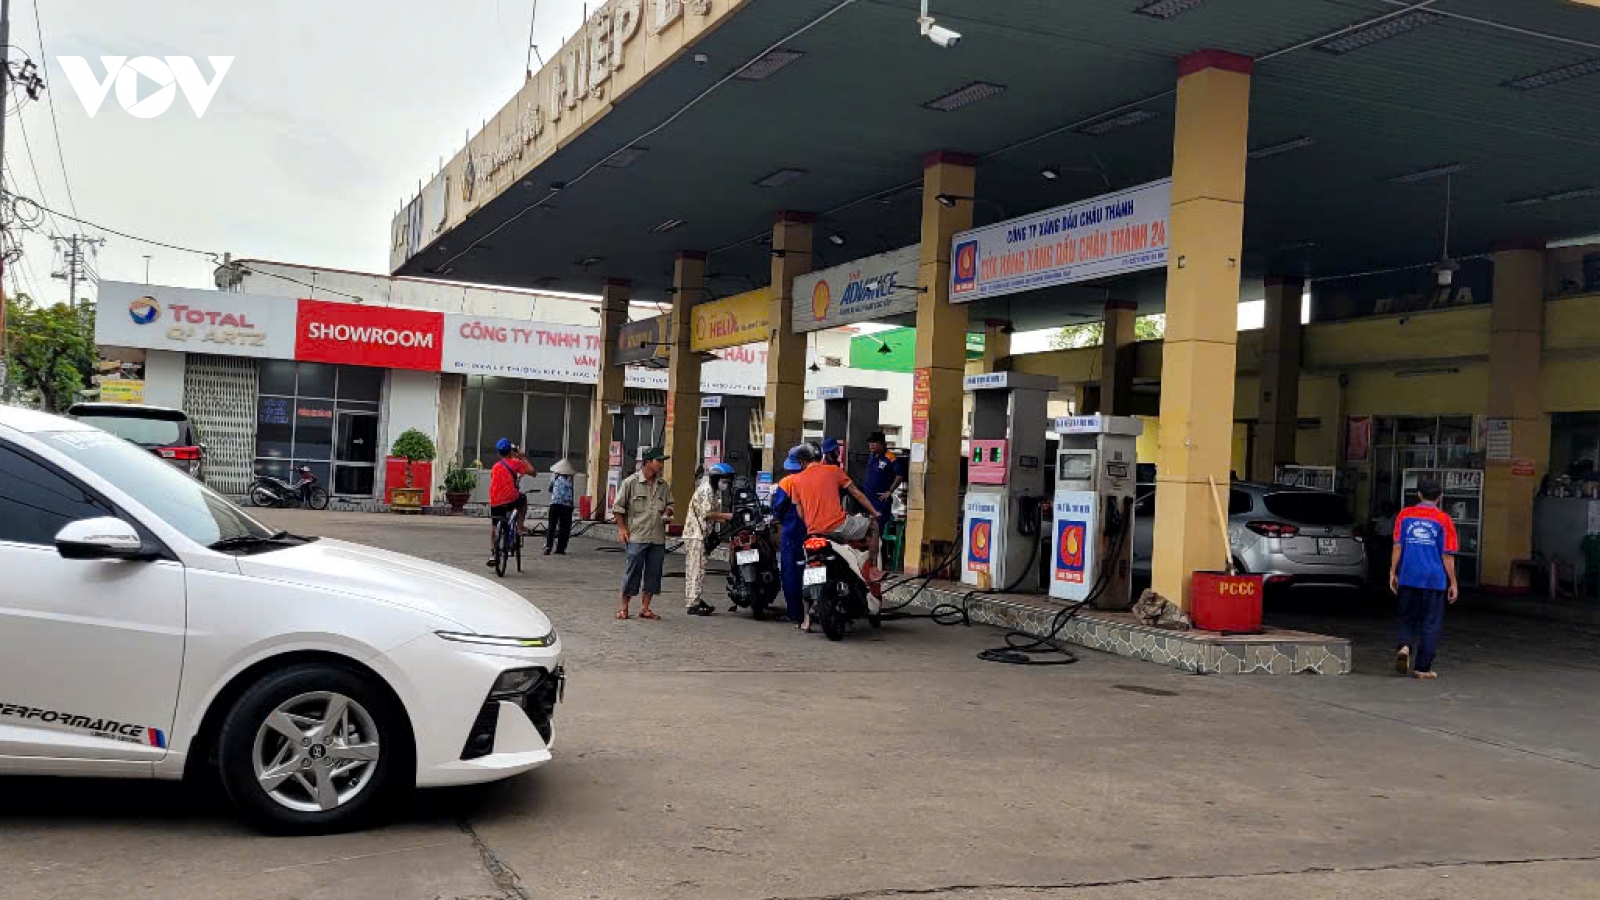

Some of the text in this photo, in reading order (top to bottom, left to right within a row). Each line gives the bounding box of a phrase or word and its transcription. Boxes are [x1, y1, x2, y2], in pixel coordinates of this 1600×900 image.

[1150, 219, 1165, 248] 24
[168, 304, 255, 329] TOTAL
[308, 322, 434, 349] SHOWROOM
[459, 321, 508, 343] CÔNG
[511, 328, 533, 344] TY
[536, 330, 581, 349] TNHH
[1219, 581, 1255, 595] PCCC
[0, 703, 145, 737] ERFORMANCE
